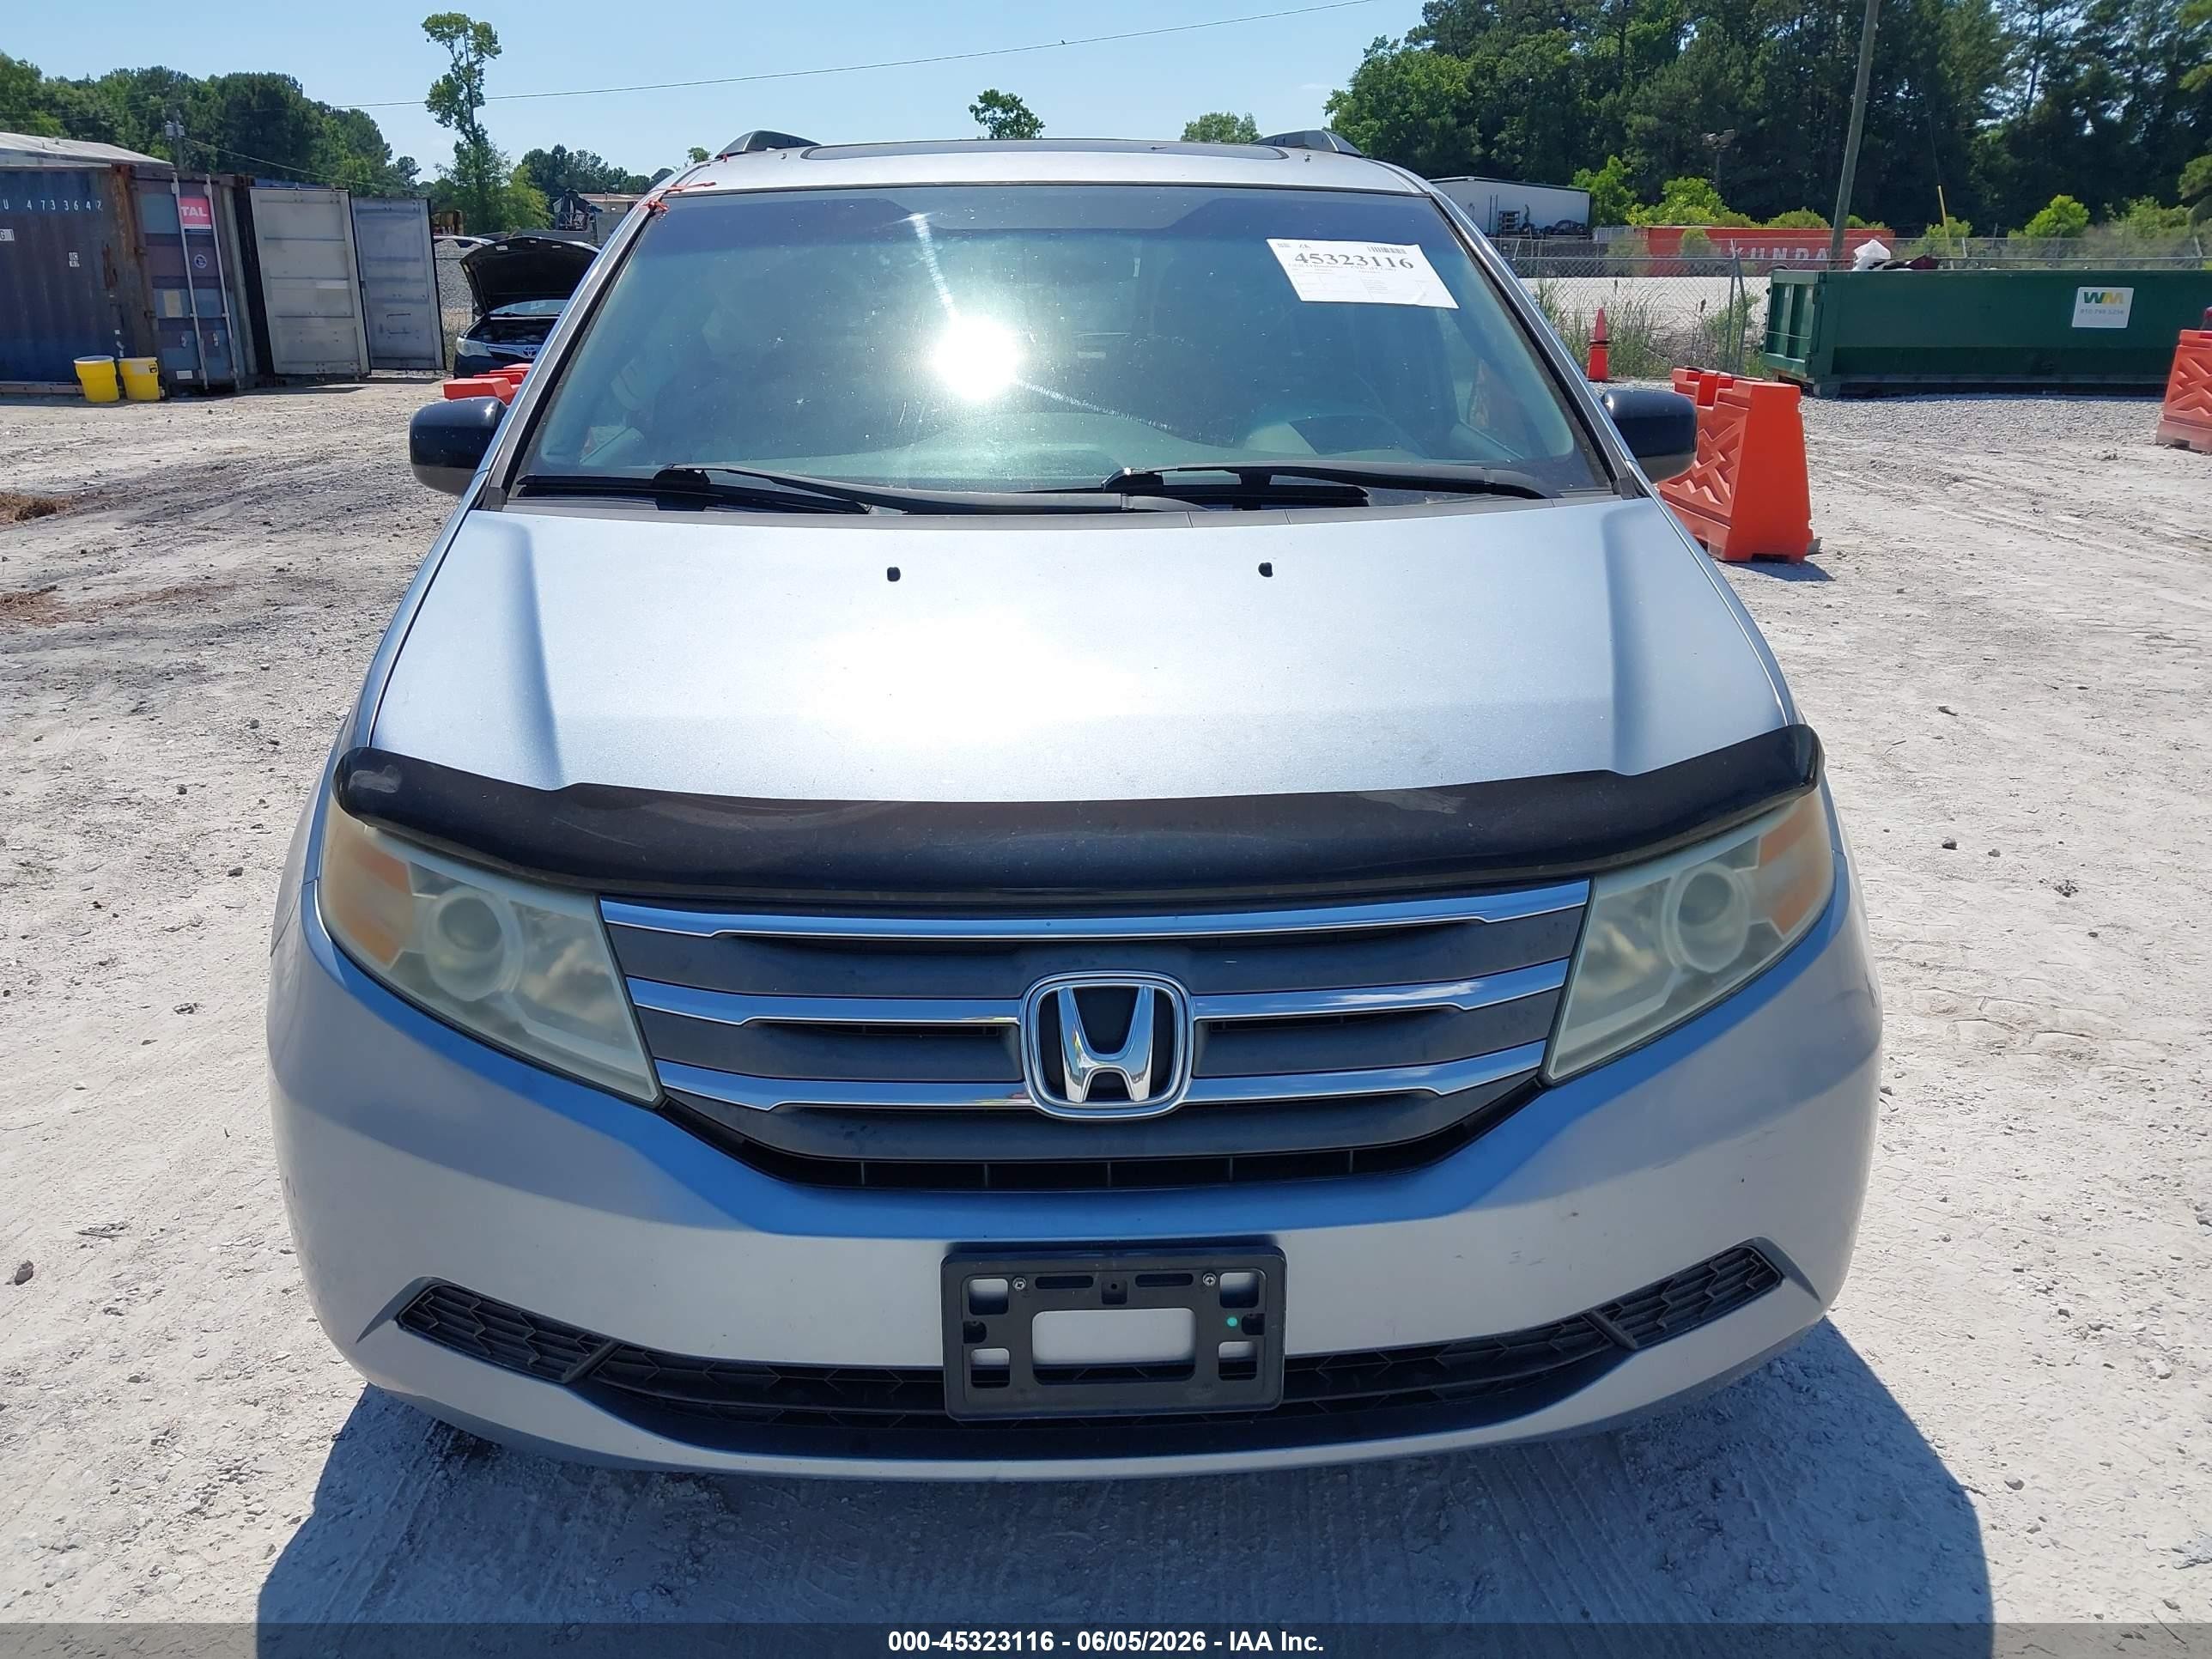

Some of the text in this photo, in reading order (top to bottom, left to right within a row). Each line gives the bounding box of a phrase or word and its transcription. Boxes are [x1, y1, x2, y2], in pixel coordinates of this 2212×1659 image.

[180, 206, 208, 217] TAL
[1294, 252, 1414, 270] 45323116
[2083, 291, 2124, 304] WM
